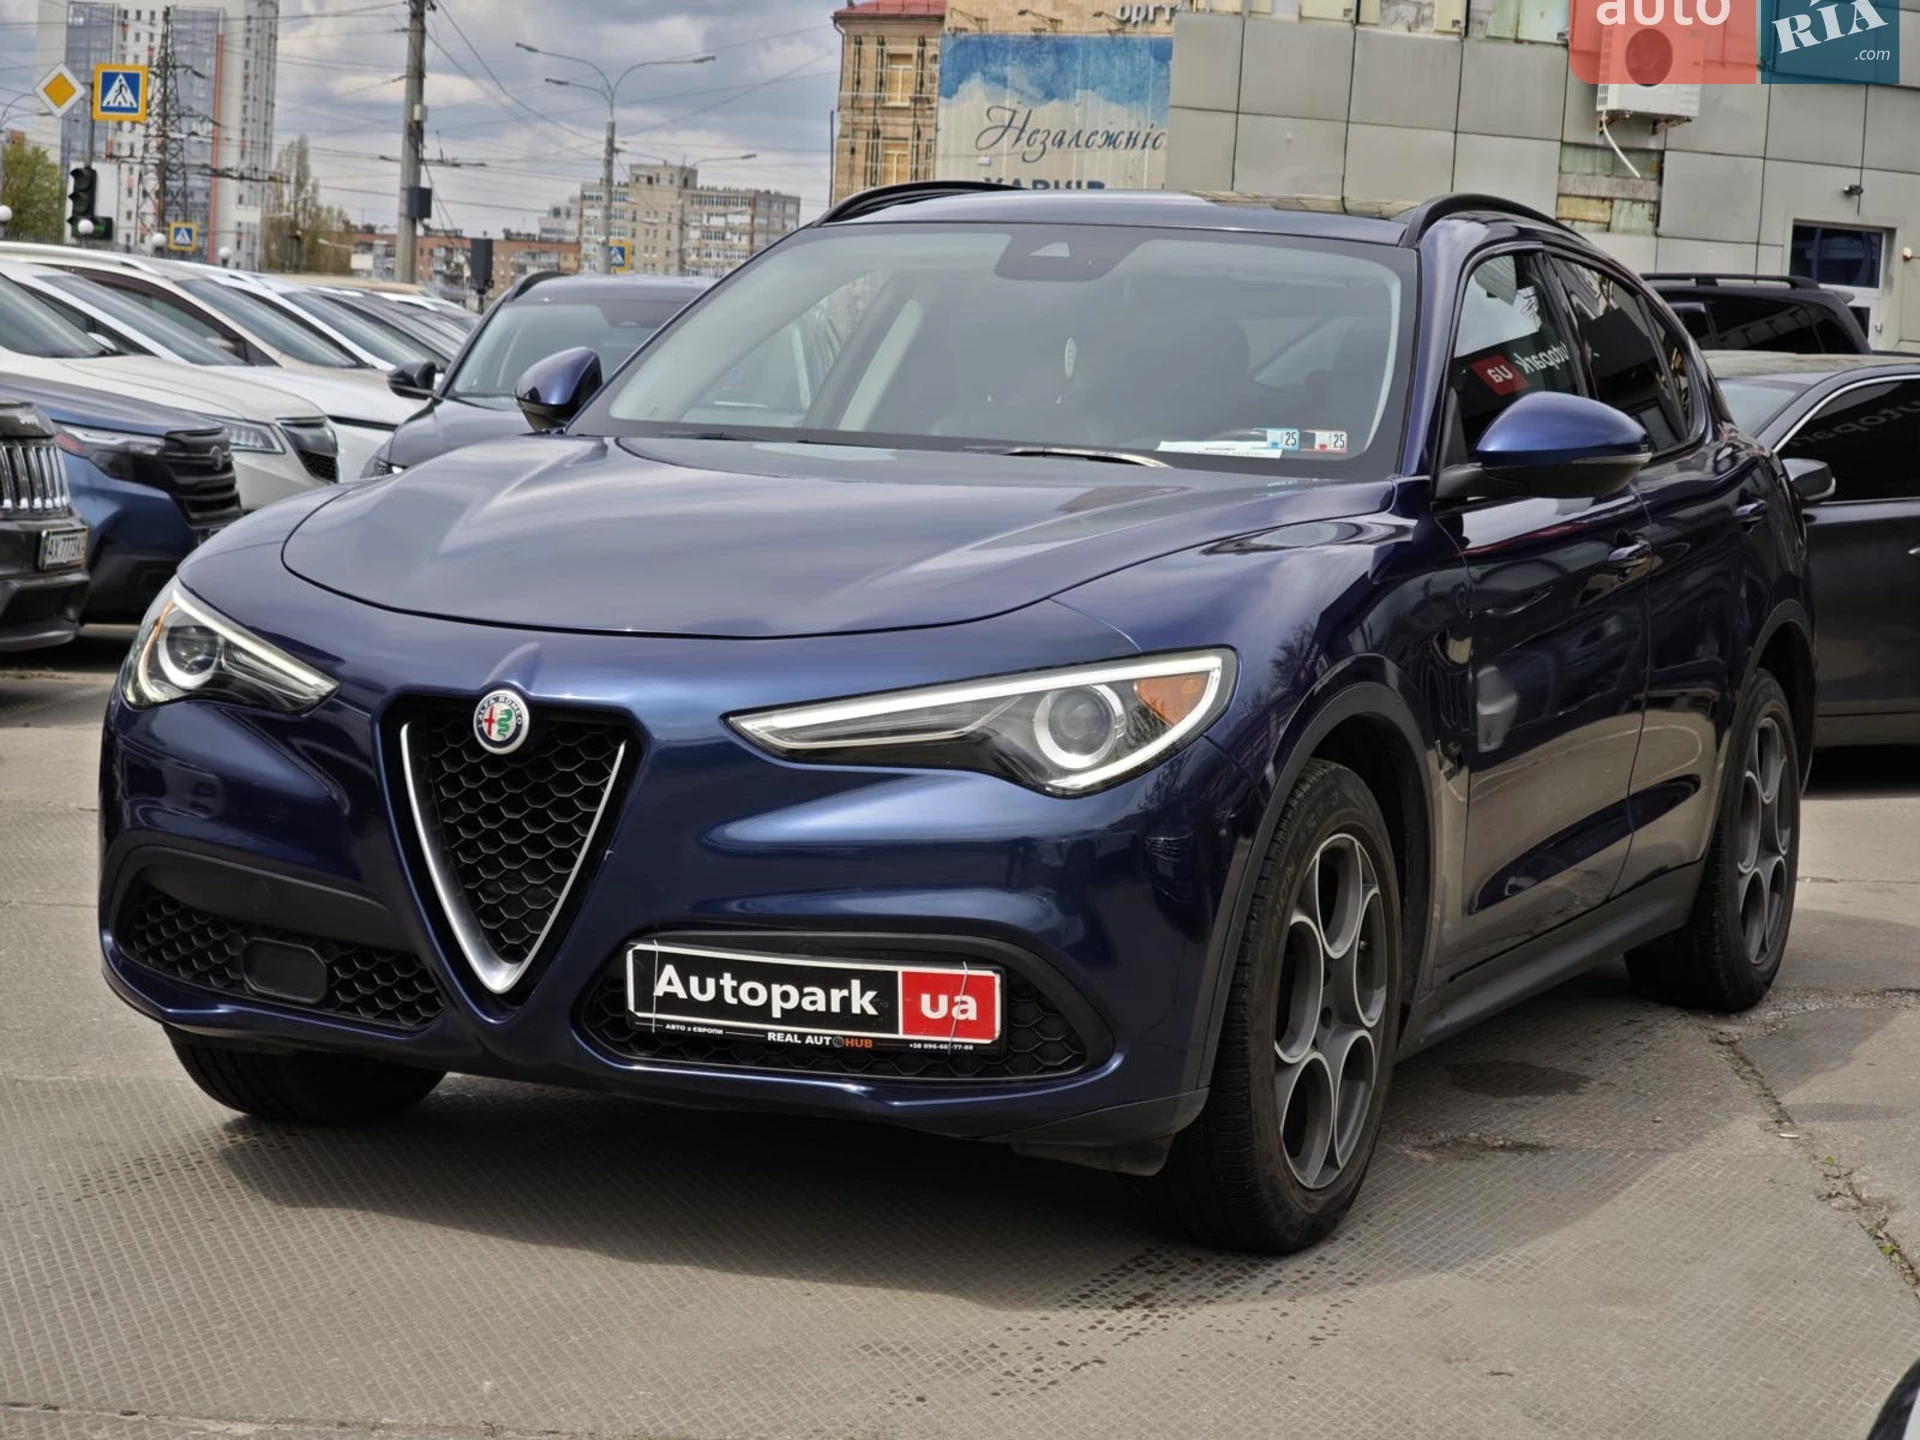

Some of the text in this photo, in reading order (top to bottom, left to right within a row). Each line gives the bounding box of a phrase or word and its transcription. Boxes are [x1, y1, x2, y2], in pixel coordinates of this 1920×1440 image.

[1284, 431, 1297, 446] 25
[1333, 433, 1345, 448] 25
[654, 963, 979, 1021] Autopark ua
[767, 1032, 802, 1044] REAL
